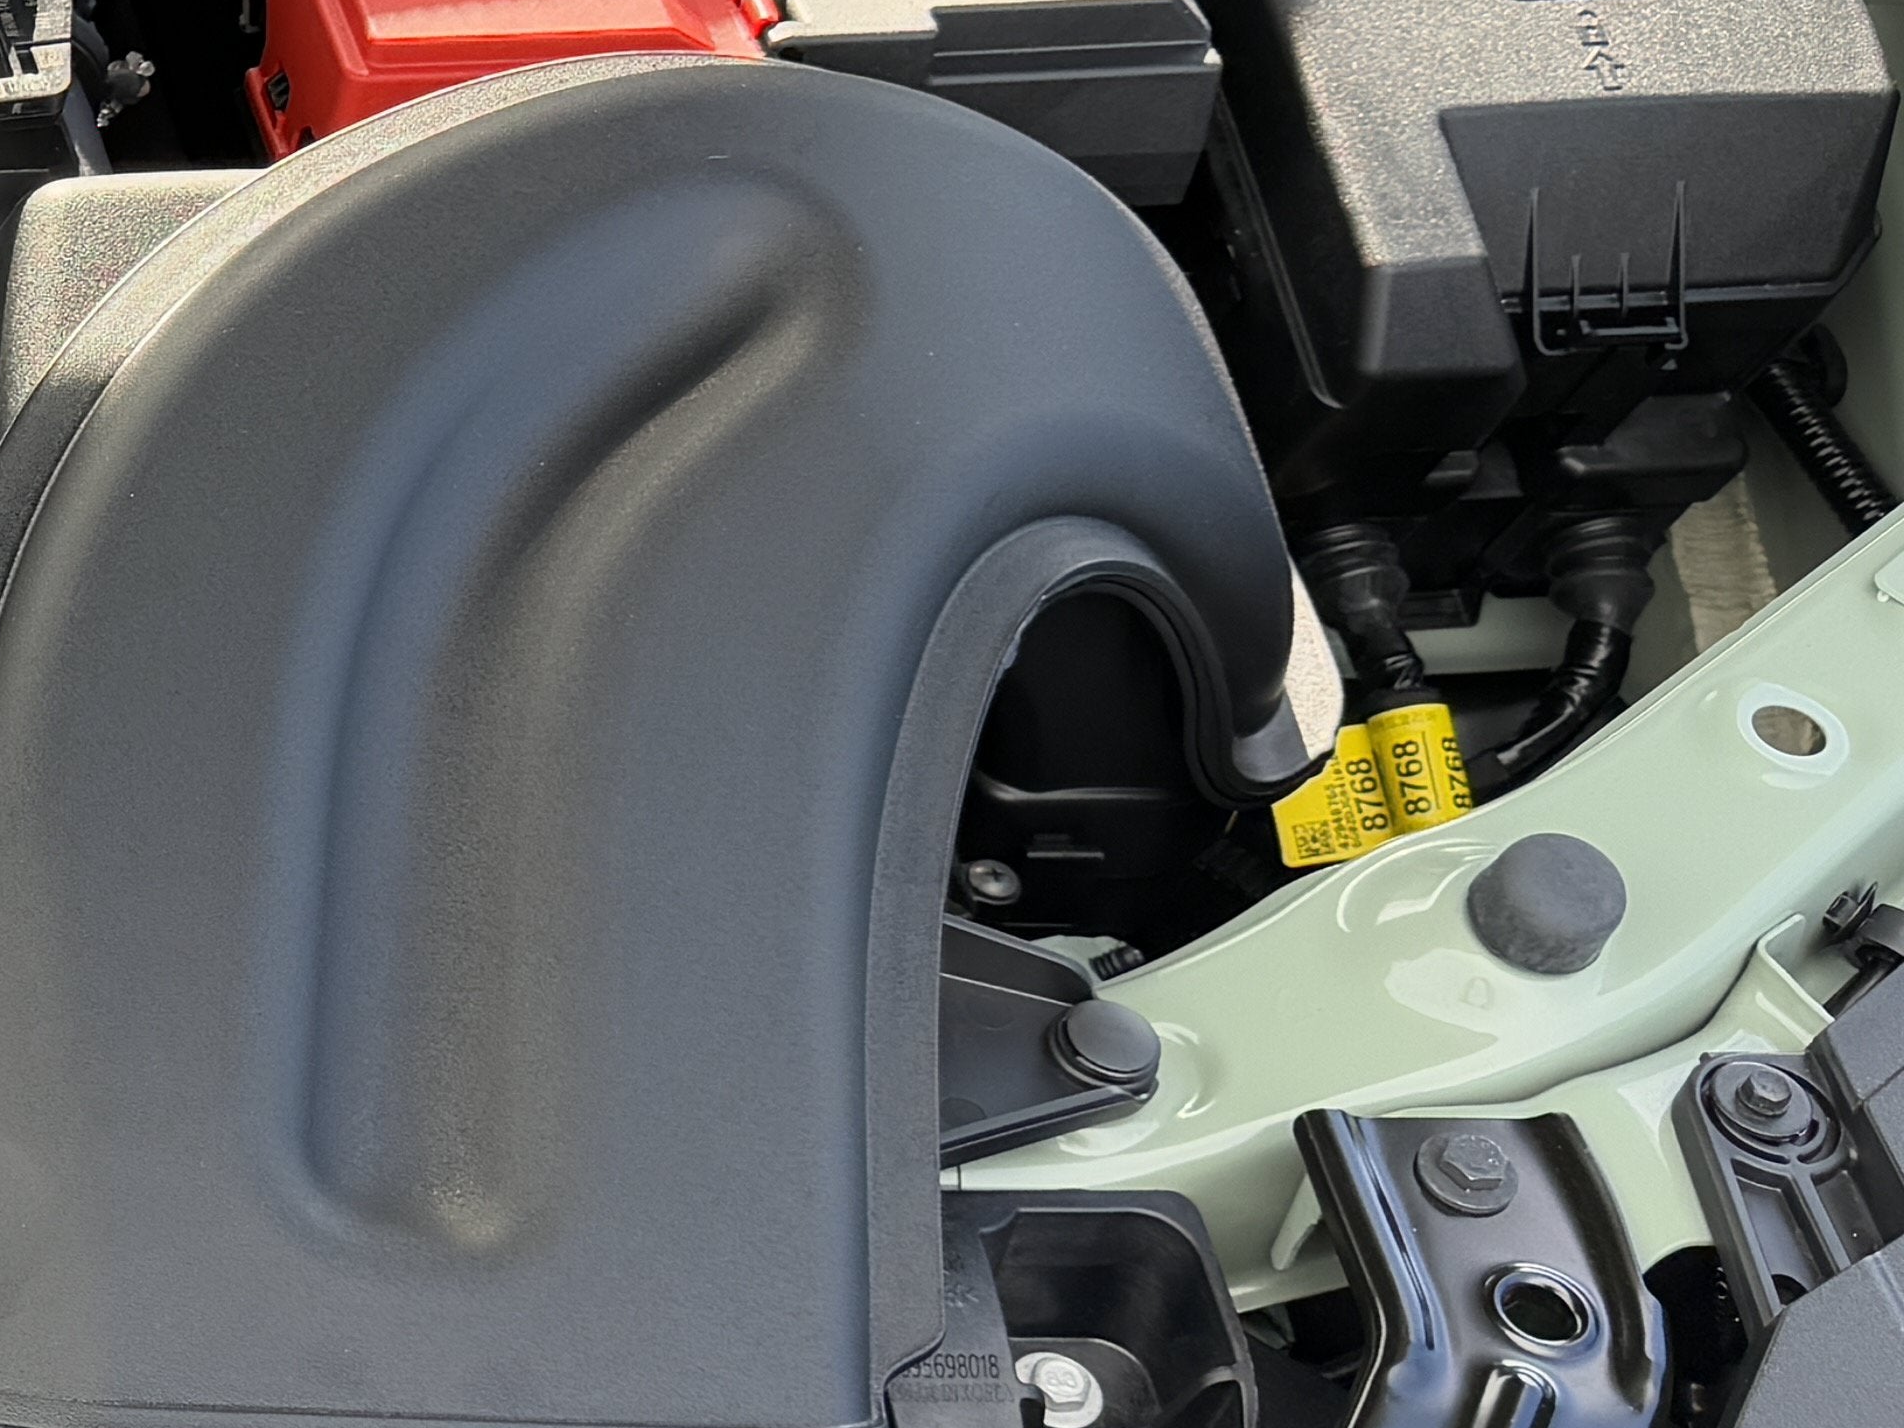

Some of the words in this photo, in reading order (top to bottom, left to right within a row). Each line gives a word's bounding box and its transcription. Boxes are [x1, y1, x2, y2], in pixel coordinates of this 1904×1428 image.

[1346, 758, 1388, 831] 8768
[1393, 740, 1431, 816] 8768
[902, 1353, 1000, 1379] 95698018
